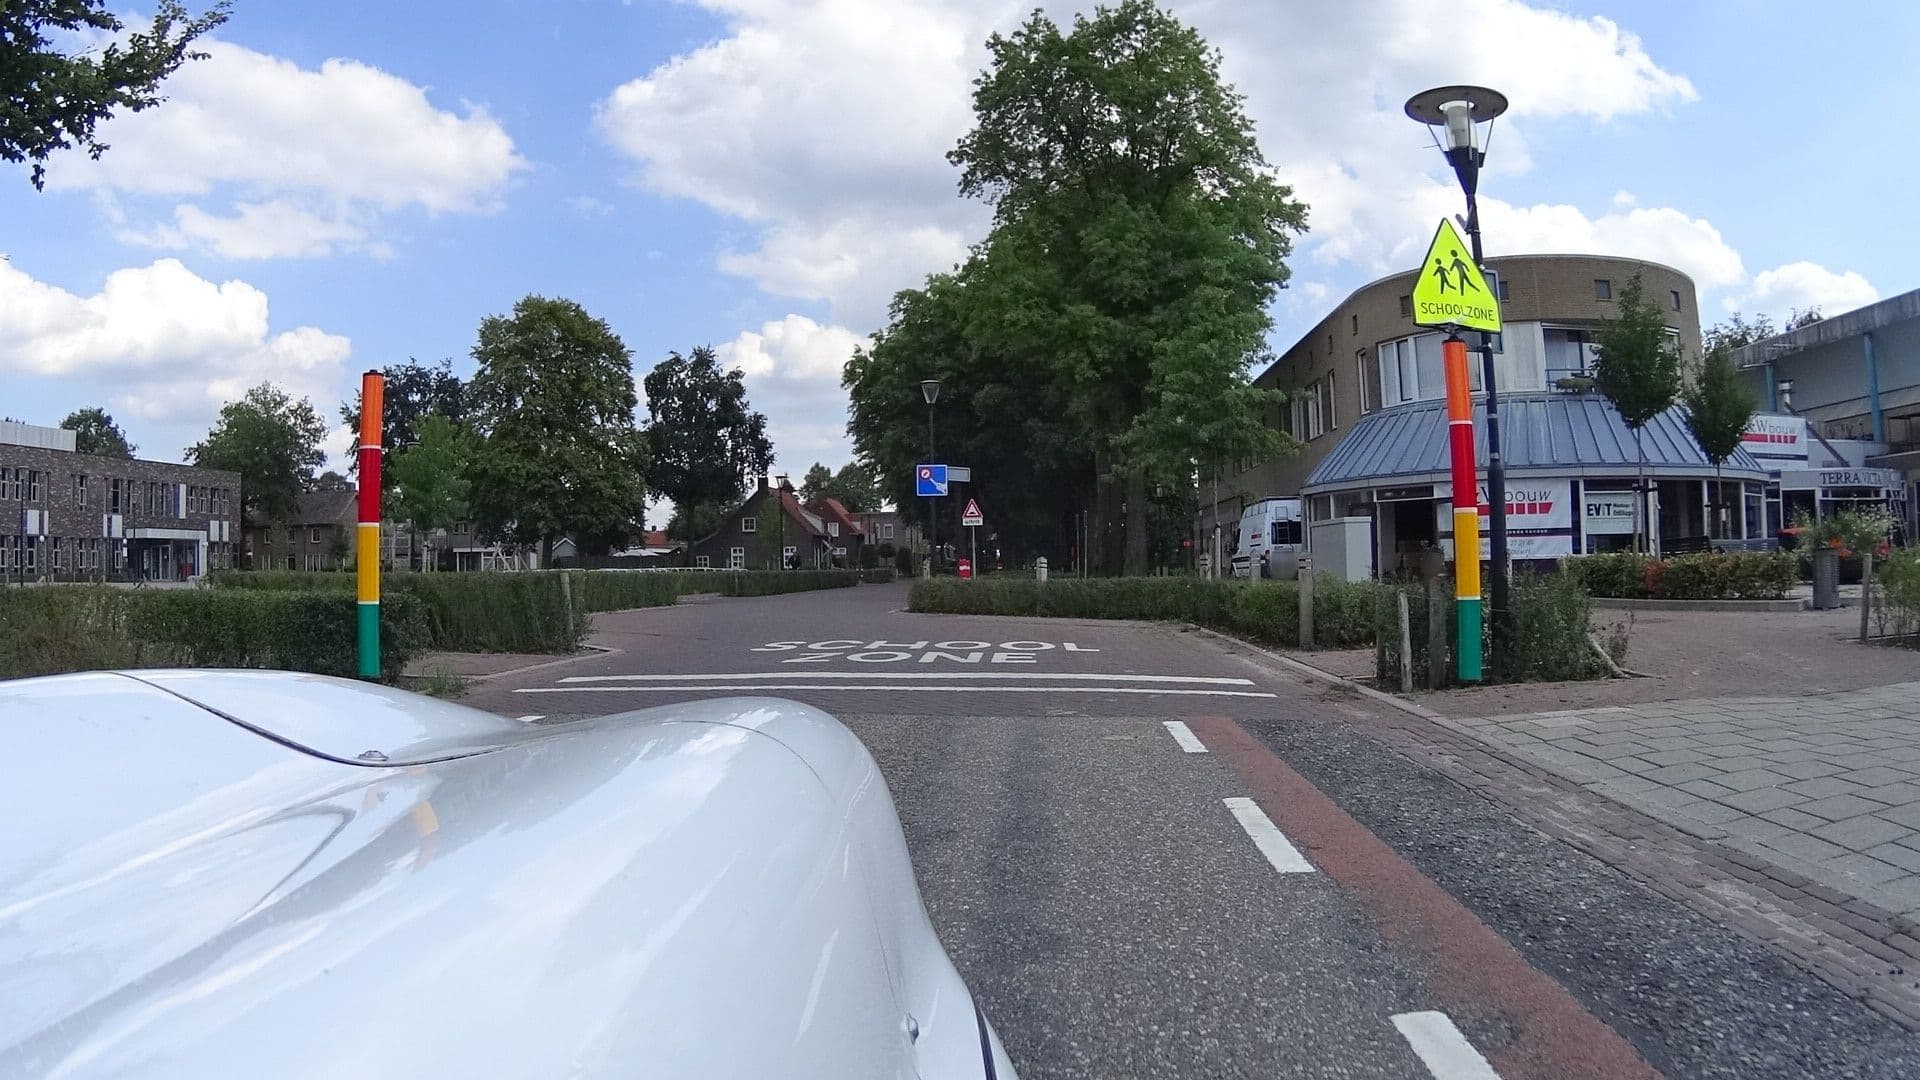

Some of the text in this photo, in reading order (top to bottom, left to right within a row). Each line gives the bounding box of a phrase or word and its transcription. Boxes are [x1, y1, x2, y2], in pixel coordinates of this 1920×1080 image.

[1420, 302, 1495, 321] SCHOOLZONE
[1820, 472, 1860, 485] TERRA
[750, 640, 1100, 652] SCHOOL
[782, 651, 1037, 663] ZONE
